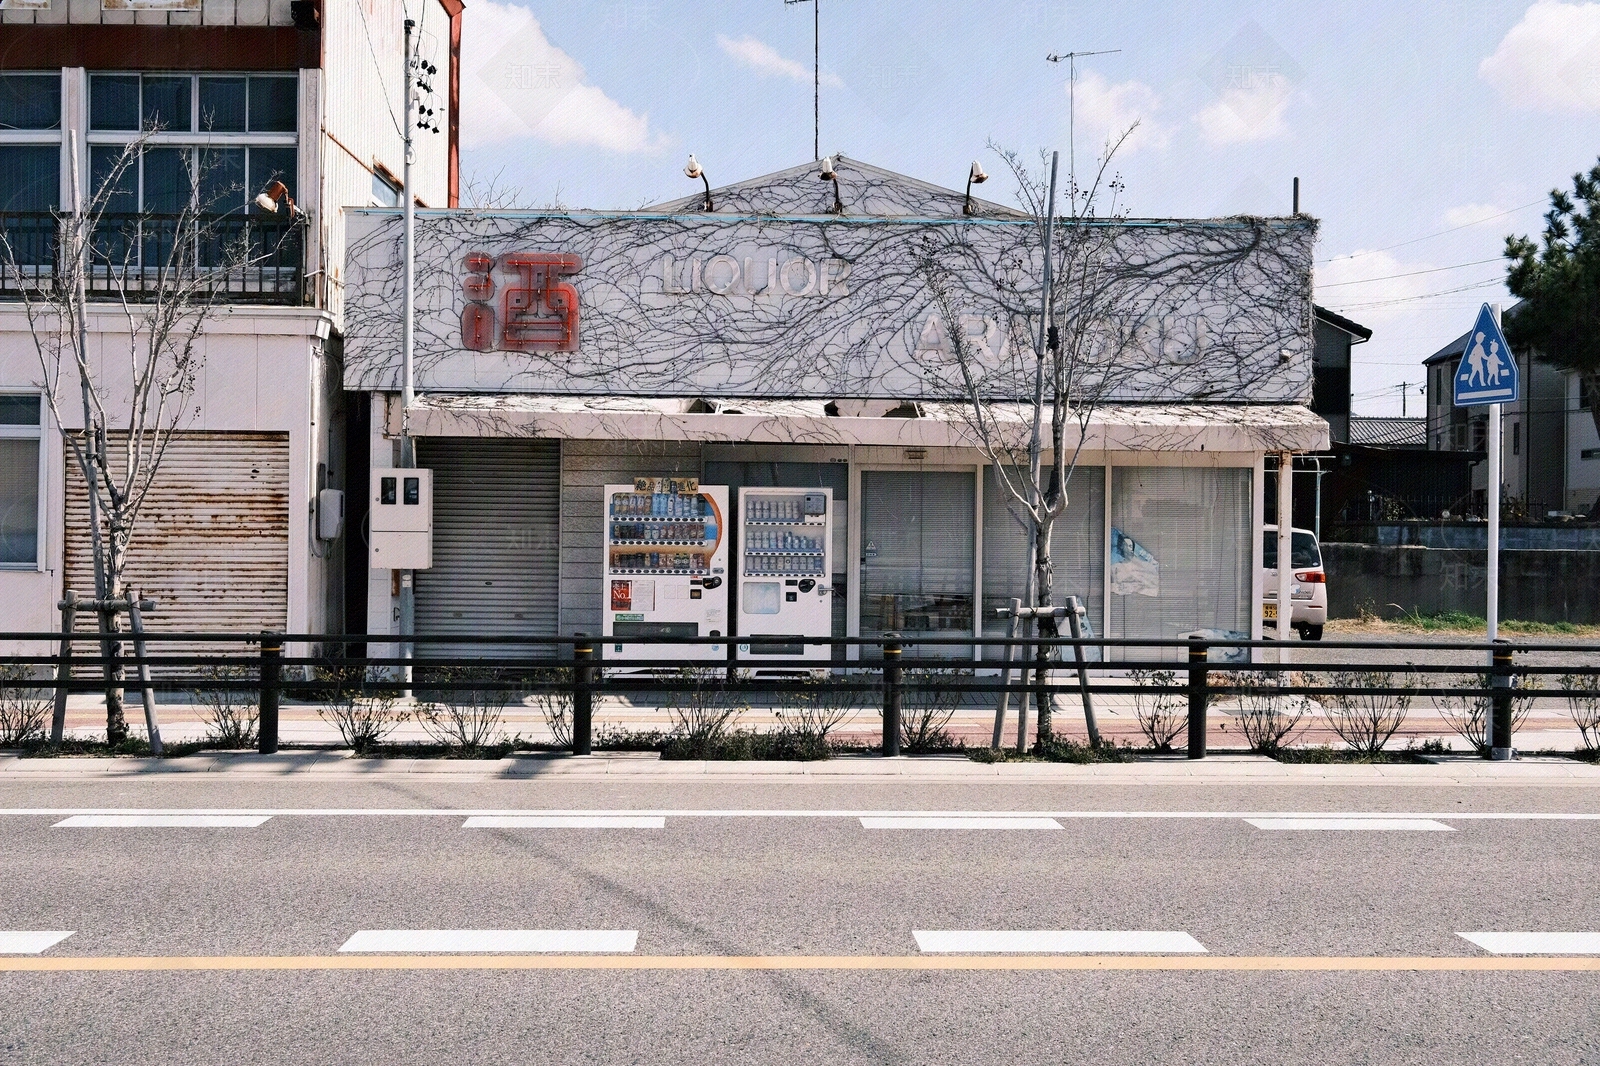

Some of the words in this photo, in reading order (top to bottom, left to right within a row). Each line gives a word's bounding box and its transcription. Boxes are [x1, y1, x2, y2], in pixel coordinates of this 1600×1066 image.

[663, 255, 851, 296] LIQUOR
[461, 251, 583, 351] 酒
[613, 582, 631, 599] No.1
[1264, 610, 1277, 618] 92-
